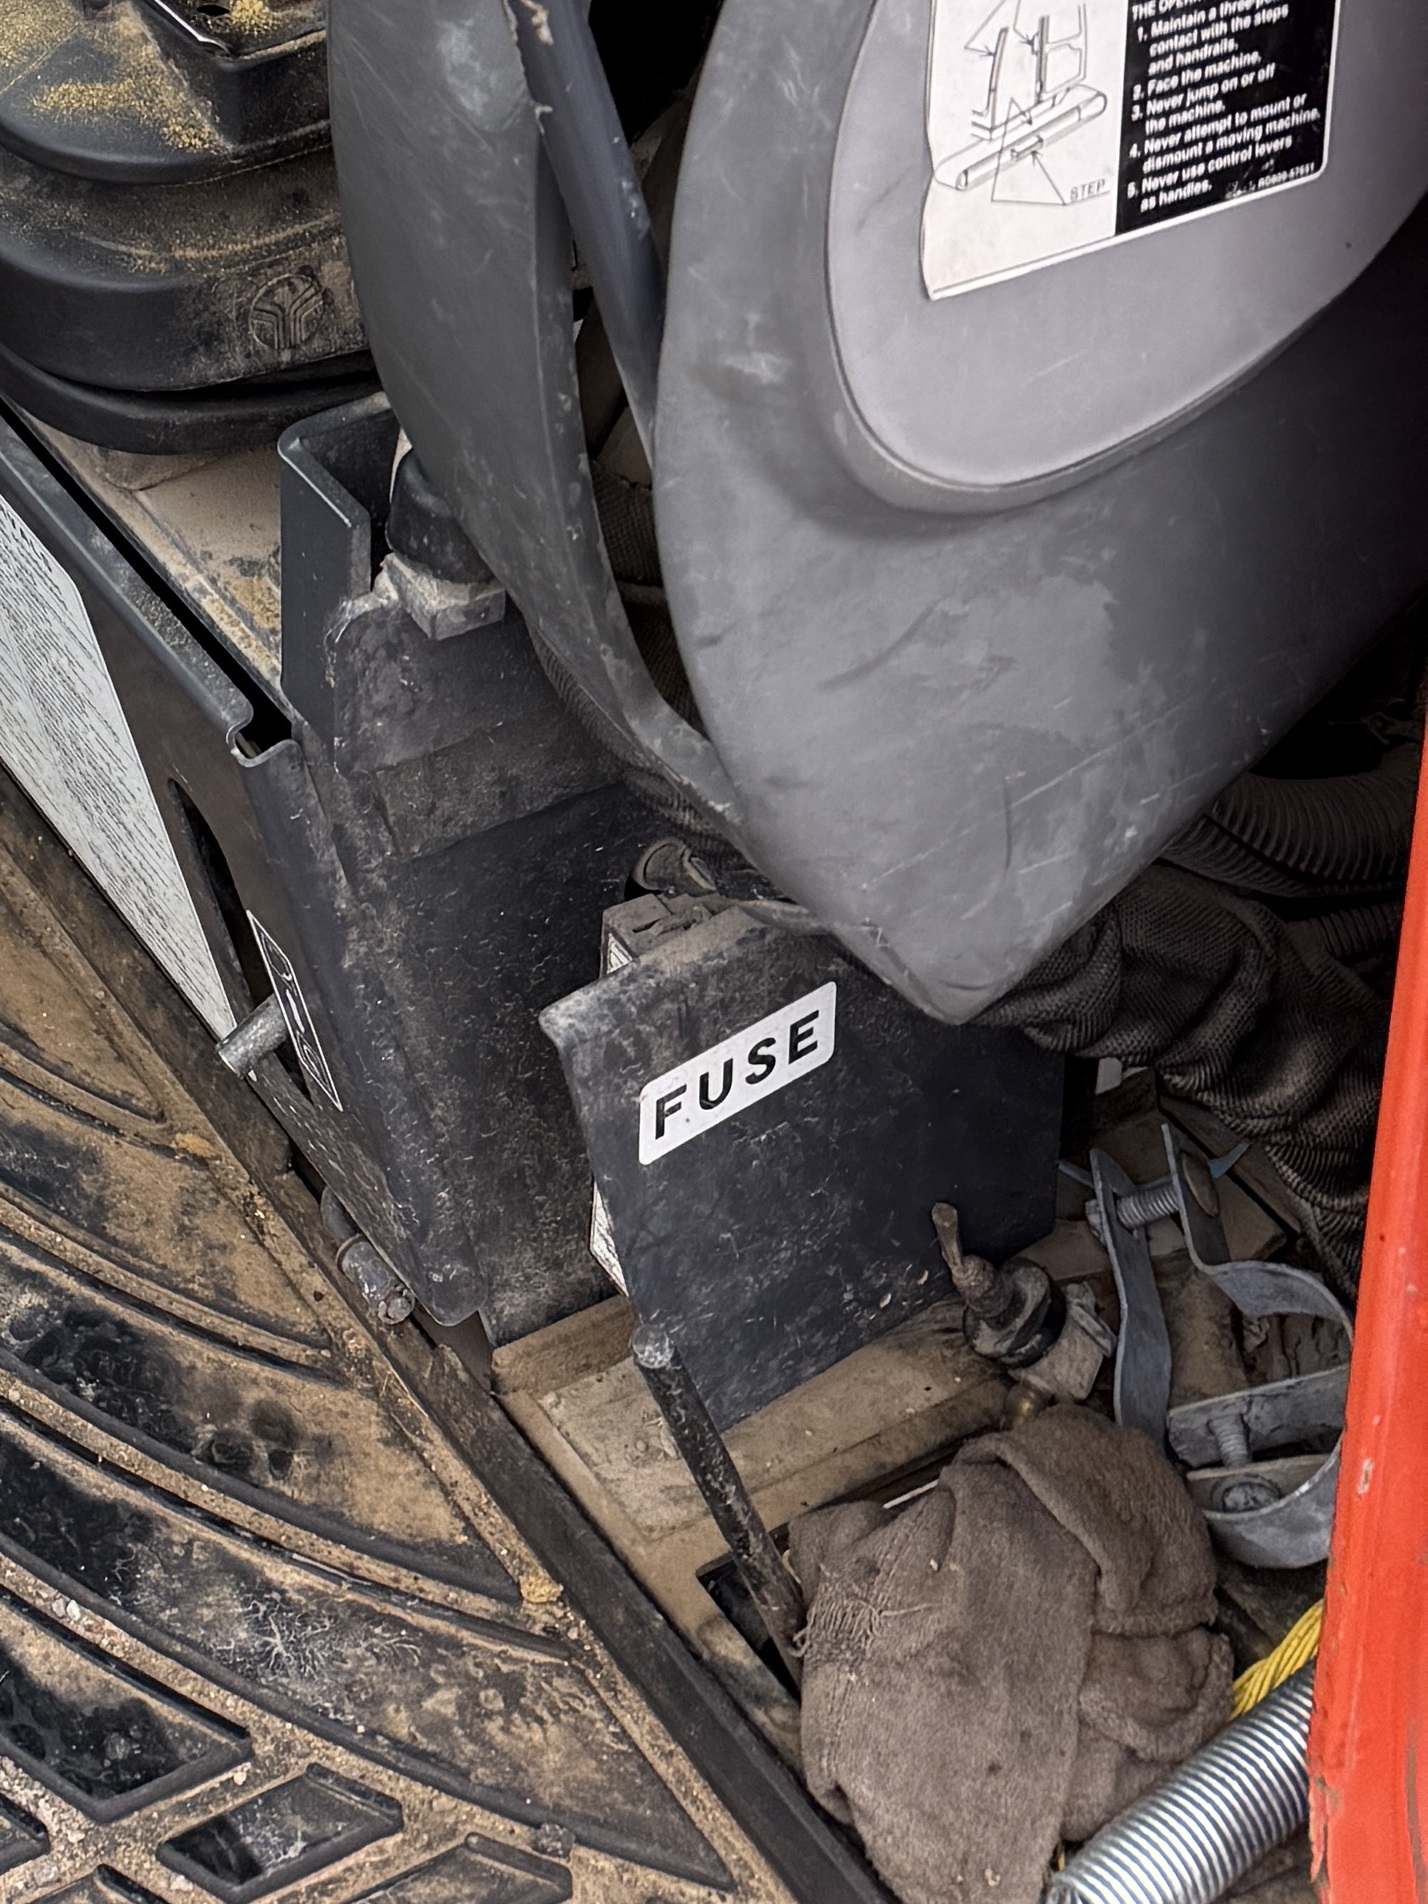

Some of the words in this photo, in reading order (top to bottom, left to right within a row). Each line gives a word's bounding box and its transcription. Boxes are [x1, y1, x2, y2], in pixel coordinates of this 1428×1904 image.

[1132, 0, 1156, 21] THE
[1150, 9, 1205, 37] Maintain
[1207, 6, 1216, 21] a
[1149, 28, 1198, 56] contact
[1200, 21, 1227, 41] with
[1230, 15, 1251, 32] the
[1253, 4, 1288, 26] steps
[1148, 53, 1173, 75] and
[1146, 93, 1184, 115] Never
[1185, 82, 1218, 106] jump
[1220, 76, 1238, 93] on
[1240, 71, 1255, 87] or
[1257, 62, 1275, 82] off
[1147, 75, 1178, 96] Face
[1180, 68, 1202, 85] the
[1143, 131, 1181, 154] Never
[1183, 114, 1232, 142] attempt
[1234, 111, 1247, 126] to
[1250, 97, 1290, 121] mount
[1292, 93, 1306, 108] or
[1145, 117, 1166, 135] the
[1141, 170, 1179, 193] Never
[1181, 162, 1205, 181] use
[1207, 145, 1252, 173] control
[1254, 135, 1292, 157] levers
[1142, 141, 1202, 173] dismount
[1205, 140, 1213, 154] a
[1215, 124, 1262, 150] moving
[1070, 178, 1107, 201] STEP
[1140, 195, 1156, 212] as
[655, 1010, 820, 1140] FUSE
